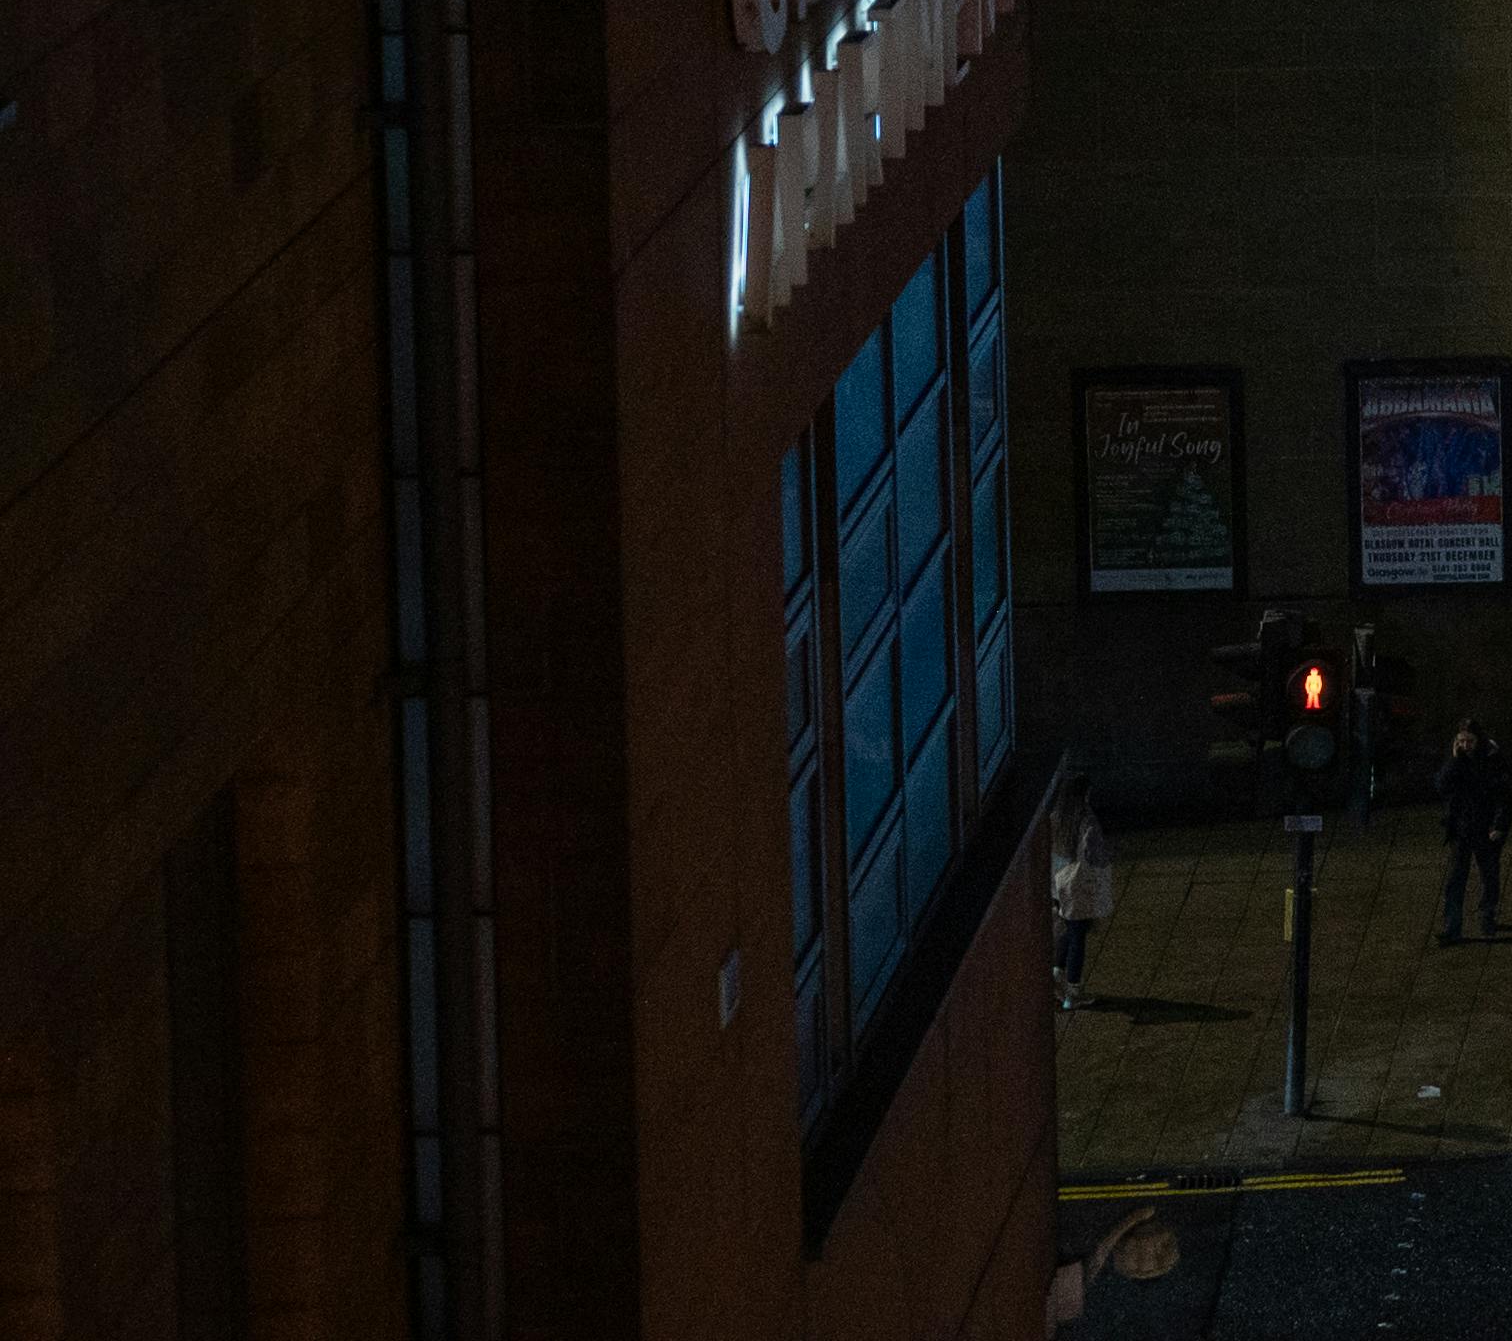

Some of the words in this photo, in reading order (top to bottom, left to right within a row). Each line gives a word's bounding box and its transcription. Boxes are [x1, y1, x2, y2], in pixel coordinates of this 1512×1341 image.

[1118, 412, 1141, 437] In
[1094, 432, 1166, 465] Joyful
[1169, 430, 1222, 465] Song
